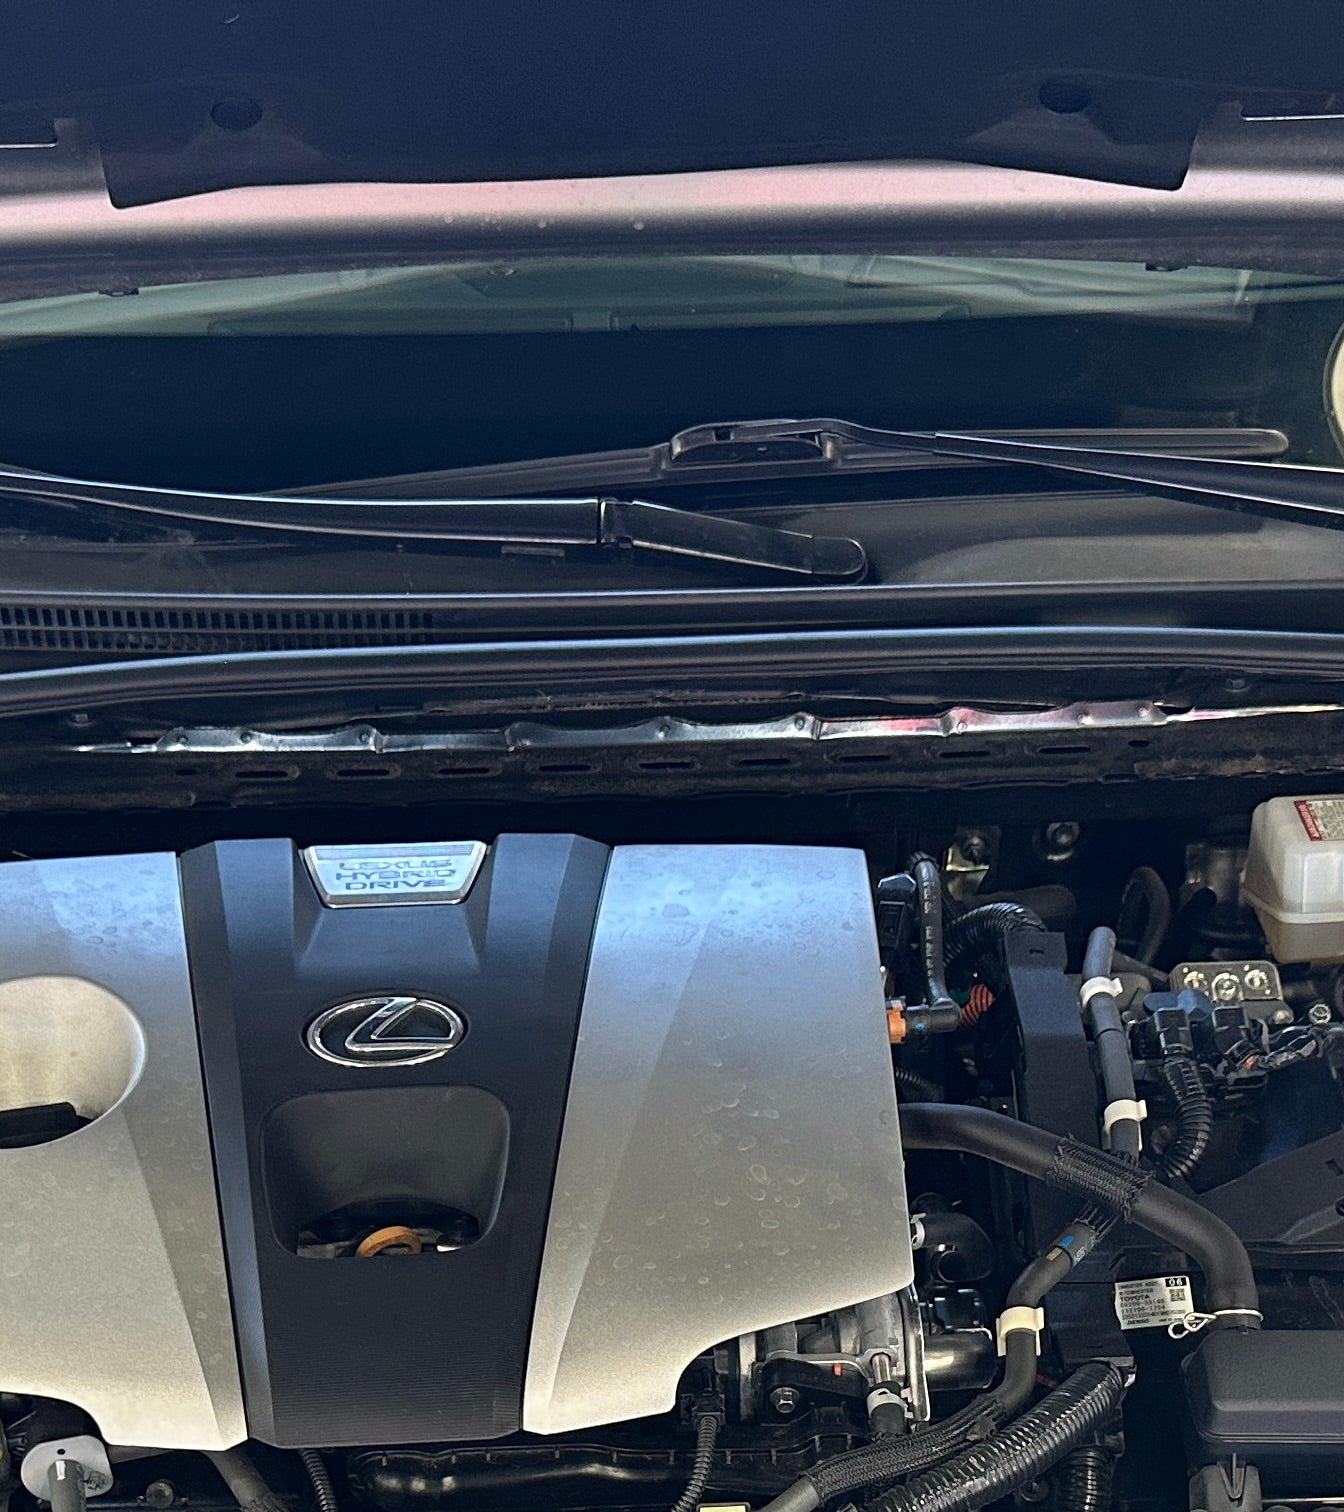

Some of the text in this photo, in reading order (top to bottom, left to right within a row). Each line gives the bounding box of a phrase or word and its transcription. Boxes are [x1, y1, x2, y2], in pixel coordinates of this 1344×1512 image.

[338, 858, 453, 870] LEXUS
[335, 869, 457, 881] HYBRID
[345, 879, 446, 890] DRIVE
